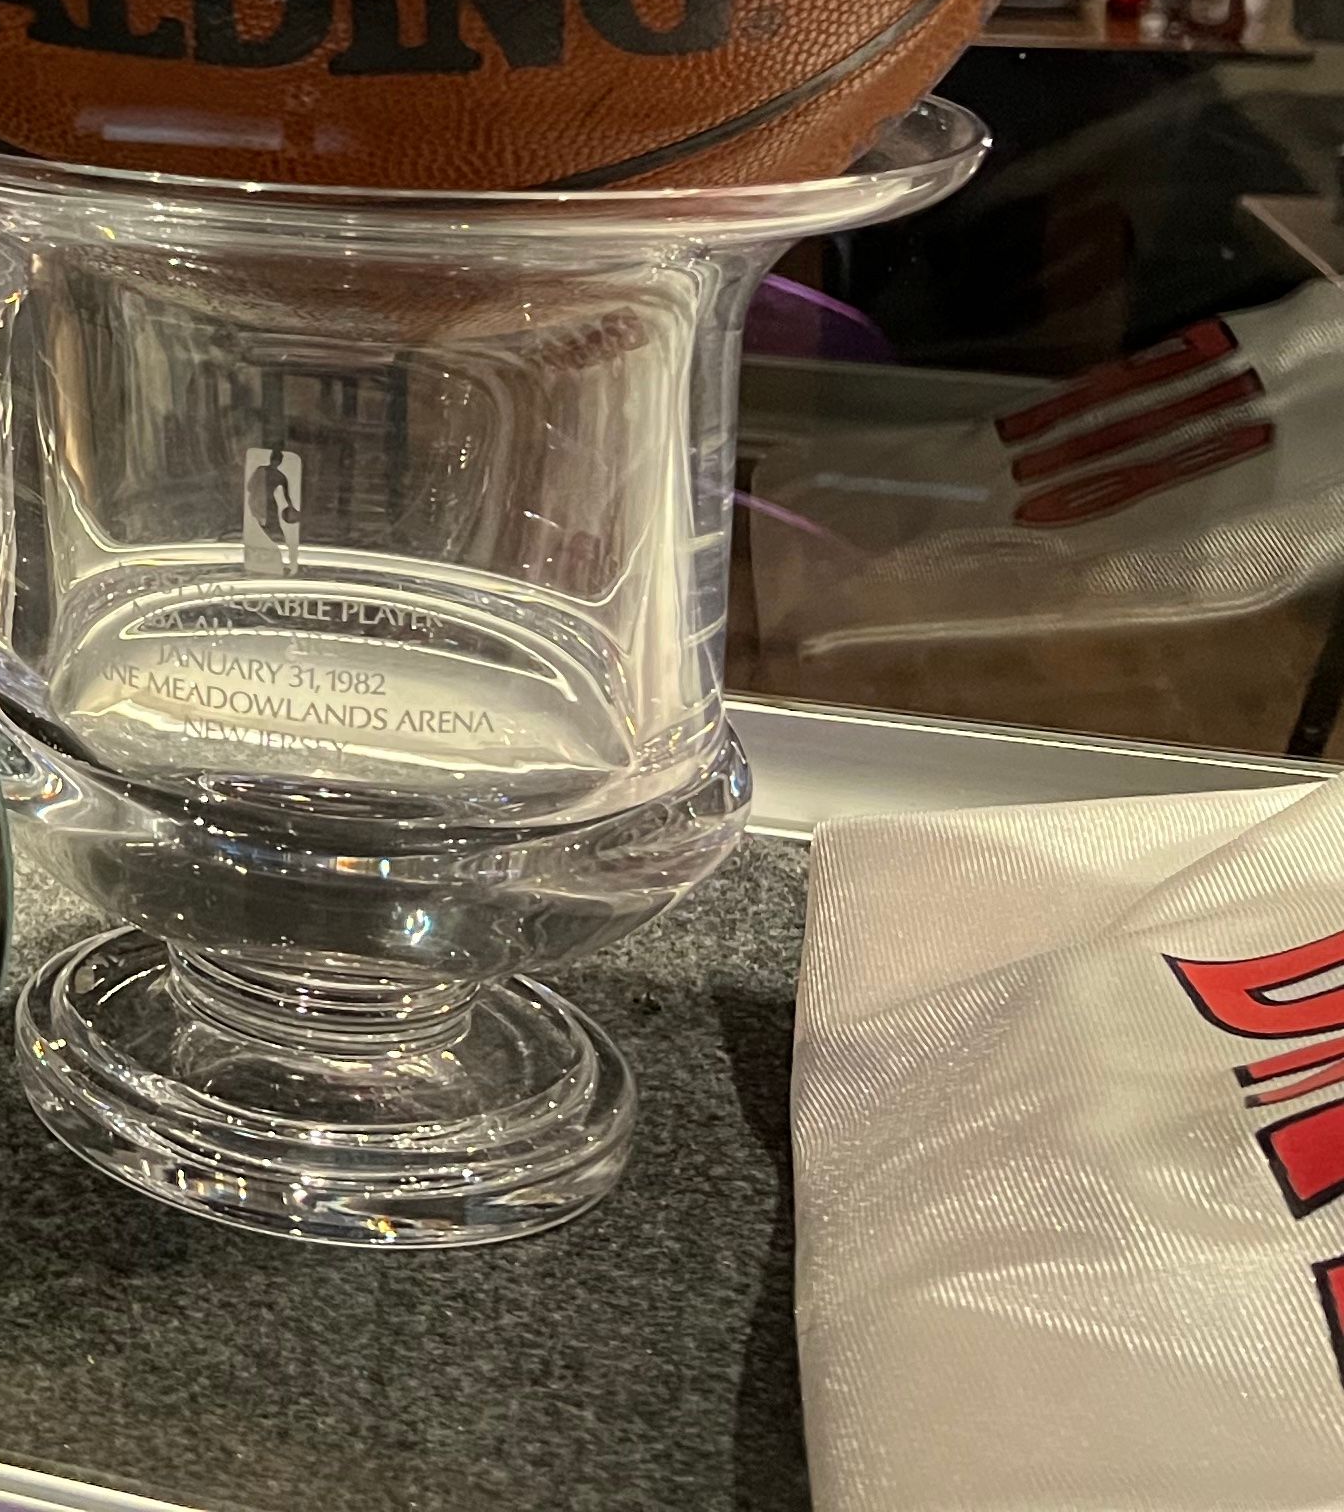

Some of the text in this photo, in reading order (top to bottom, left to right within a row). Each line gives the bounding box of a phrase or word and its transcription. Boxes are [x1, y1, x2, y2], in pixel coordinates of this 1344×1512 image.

[156, 643, 387, 696] JANUARY 31, 1982
[147, 671, 388, 732] MEADOWLANDS
[395, 708, 495, 734] ARENA
